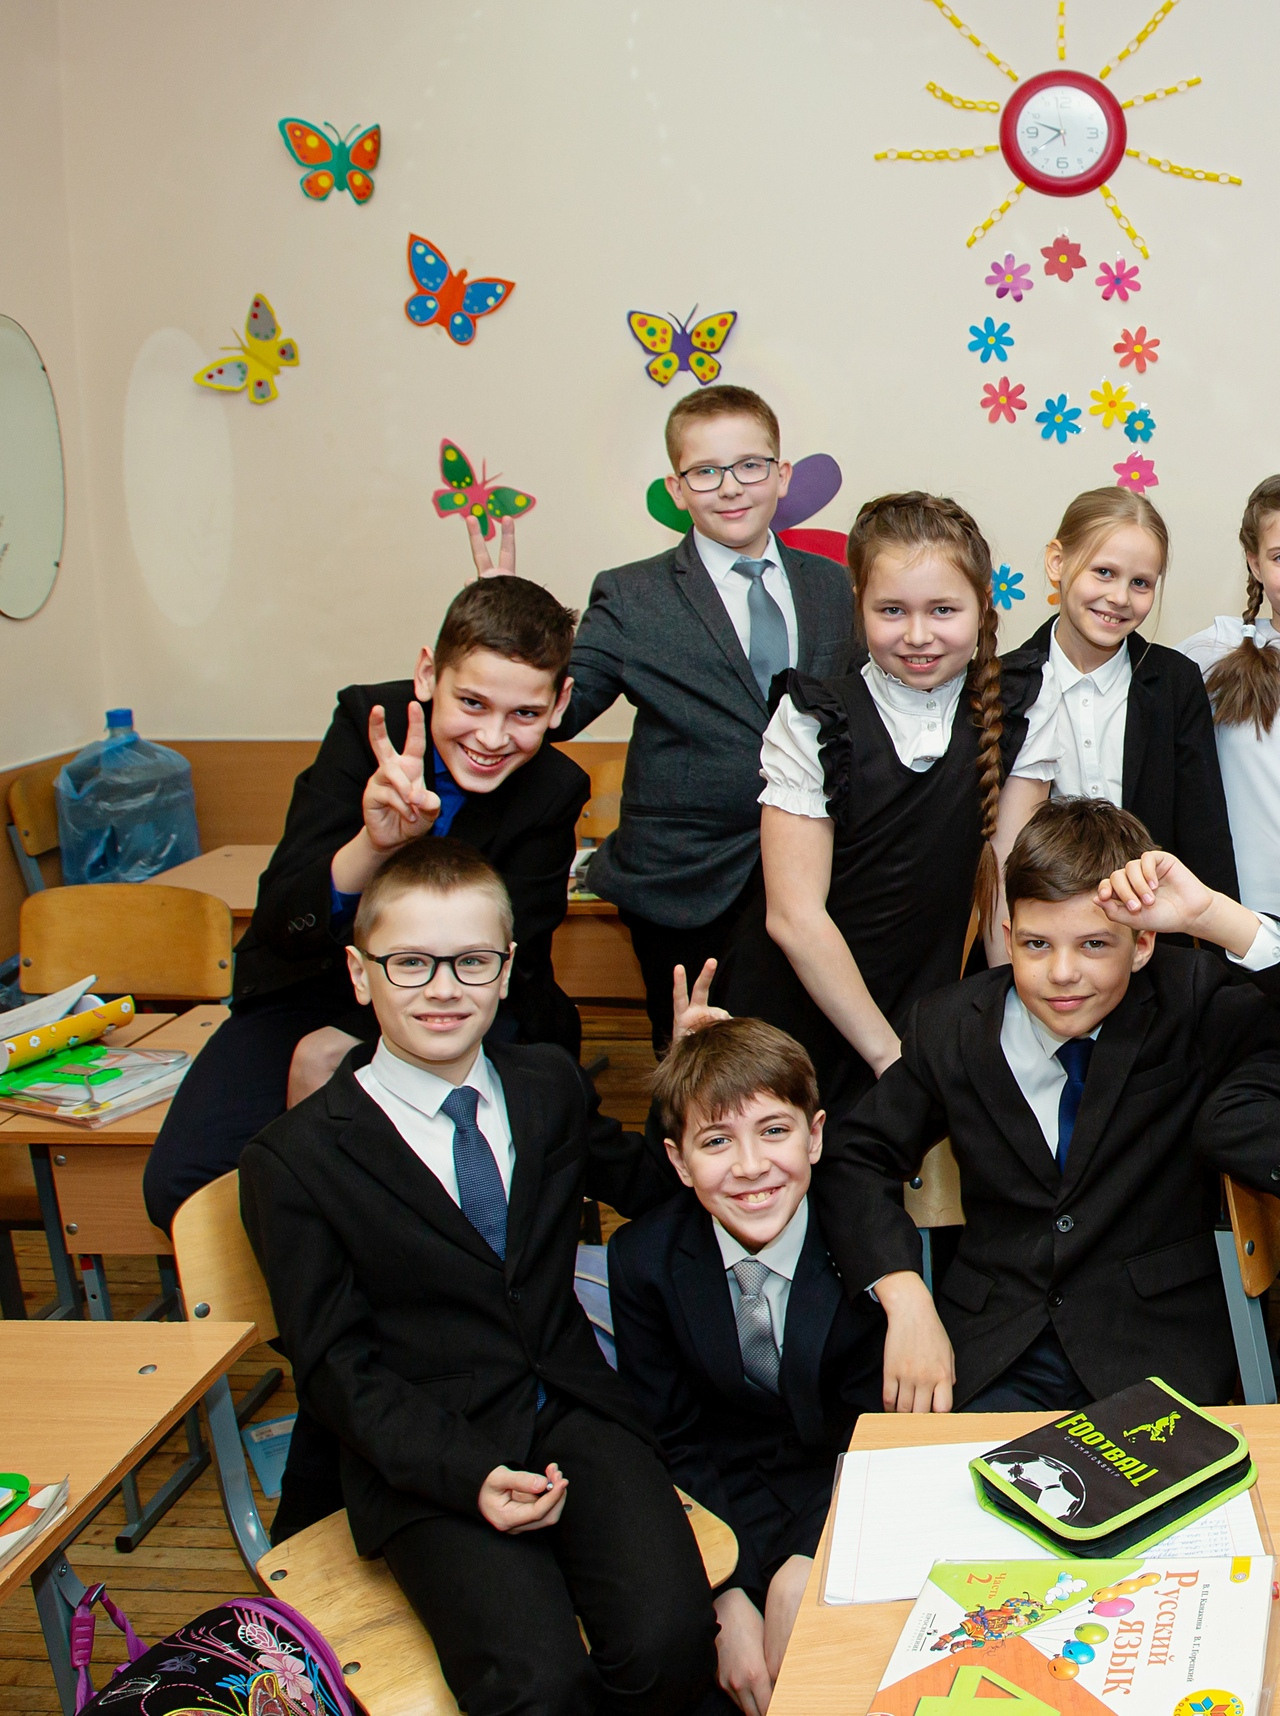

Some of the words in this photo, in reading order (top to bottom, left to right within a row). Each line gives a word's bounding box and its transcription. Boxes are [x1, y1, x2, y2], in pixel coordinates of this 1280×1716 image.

[1026, 126, 1039, 139] 9
[1086, 127, 1099, 140] 3
[1056, 157, 1069, 169] 6
[1055, 1412, 1159, 1488] FOOTBALL
[1063, 1435, 1121, 1478] CHAMPIONSHIP
[966, 1573, 993, 1585] 2
[988, 1572, 1007, 1600] Часть
[1147, 1569, 1200, 1666] Русский
